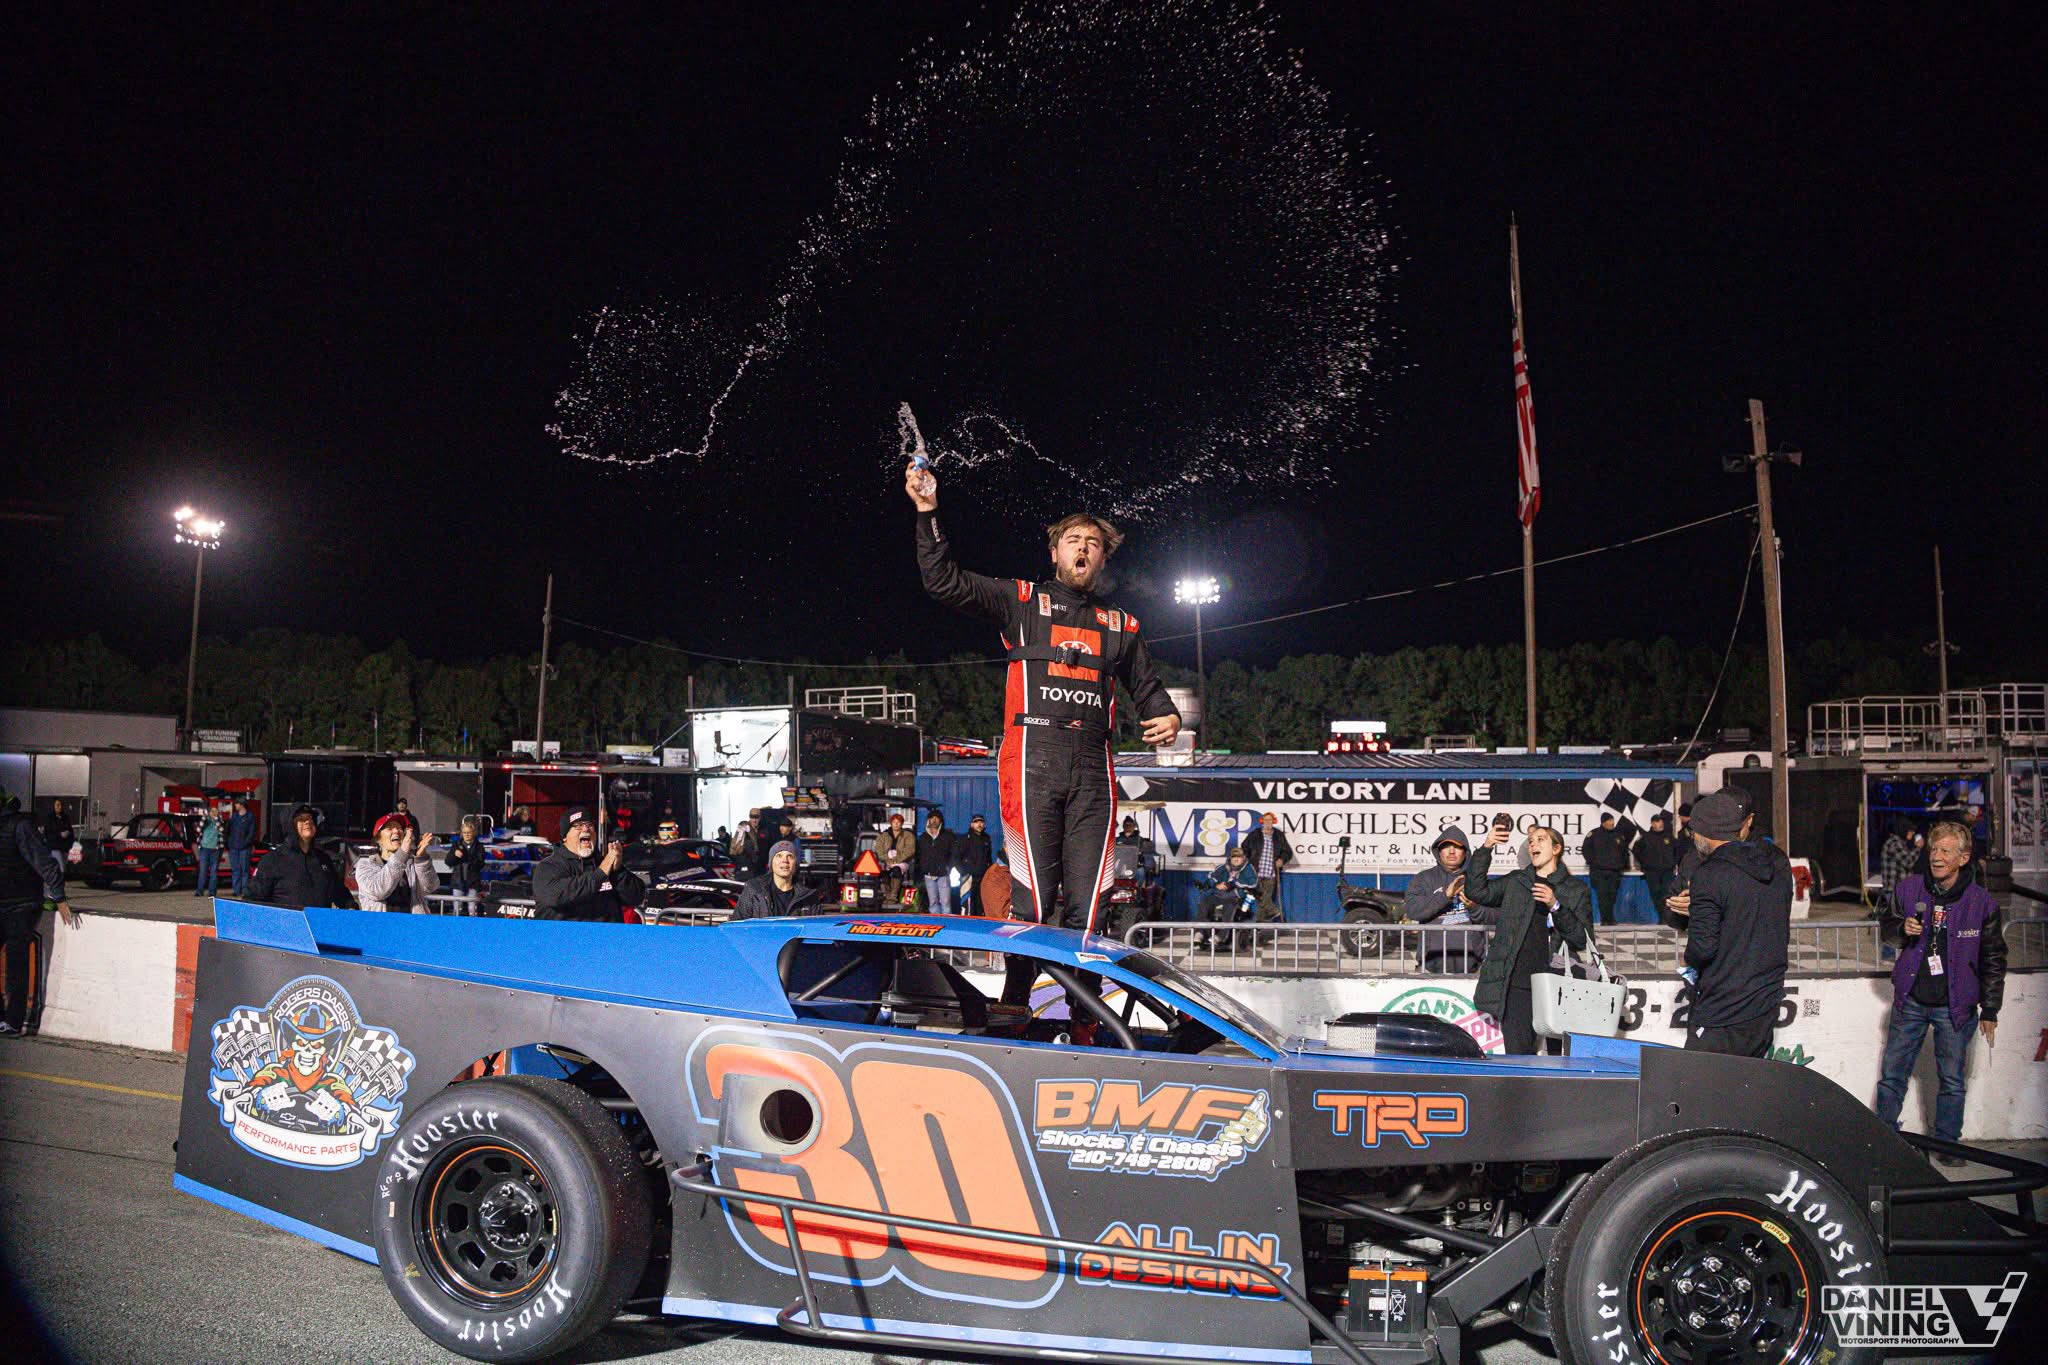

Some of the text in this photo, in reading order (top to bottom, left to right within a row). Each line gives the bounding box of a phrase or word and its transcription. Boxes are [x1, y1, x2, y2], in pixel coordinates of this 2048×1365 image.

[1040, 686, 1102, 709] TOYOTA
[1253, 781, 1491, 801] VICTORY LANE
[1281, 812, 1427, 835] MICHLES
[1470, 812, 1585, 835] BOTH
[1295, 844, 1382, 855] CCIDENT
[1388, 843, 1401, 855] &
[848, 924, 939, 937] HONEYCUTT
[274, 987, 351, 1034] ROGERS DABBS
[1036, 1082, 1257, 1132] BMF
[1316, 1094, 1466, 1145] TRD
[237, 1119, 358, 1156] PERFORMANCE PARTS
[391, 1104, 499, 1180] Hoosier
[1040, 1129, 1245, 1158] Shocks & Chassis
[705, 1043, 1048, 1282] 30
[1098, 1226, 1274, 1267] ALL IN
[1080, 1252, 1284, 1294] DESIGNS
[456, 1267, 573, 1351] Hoosier
